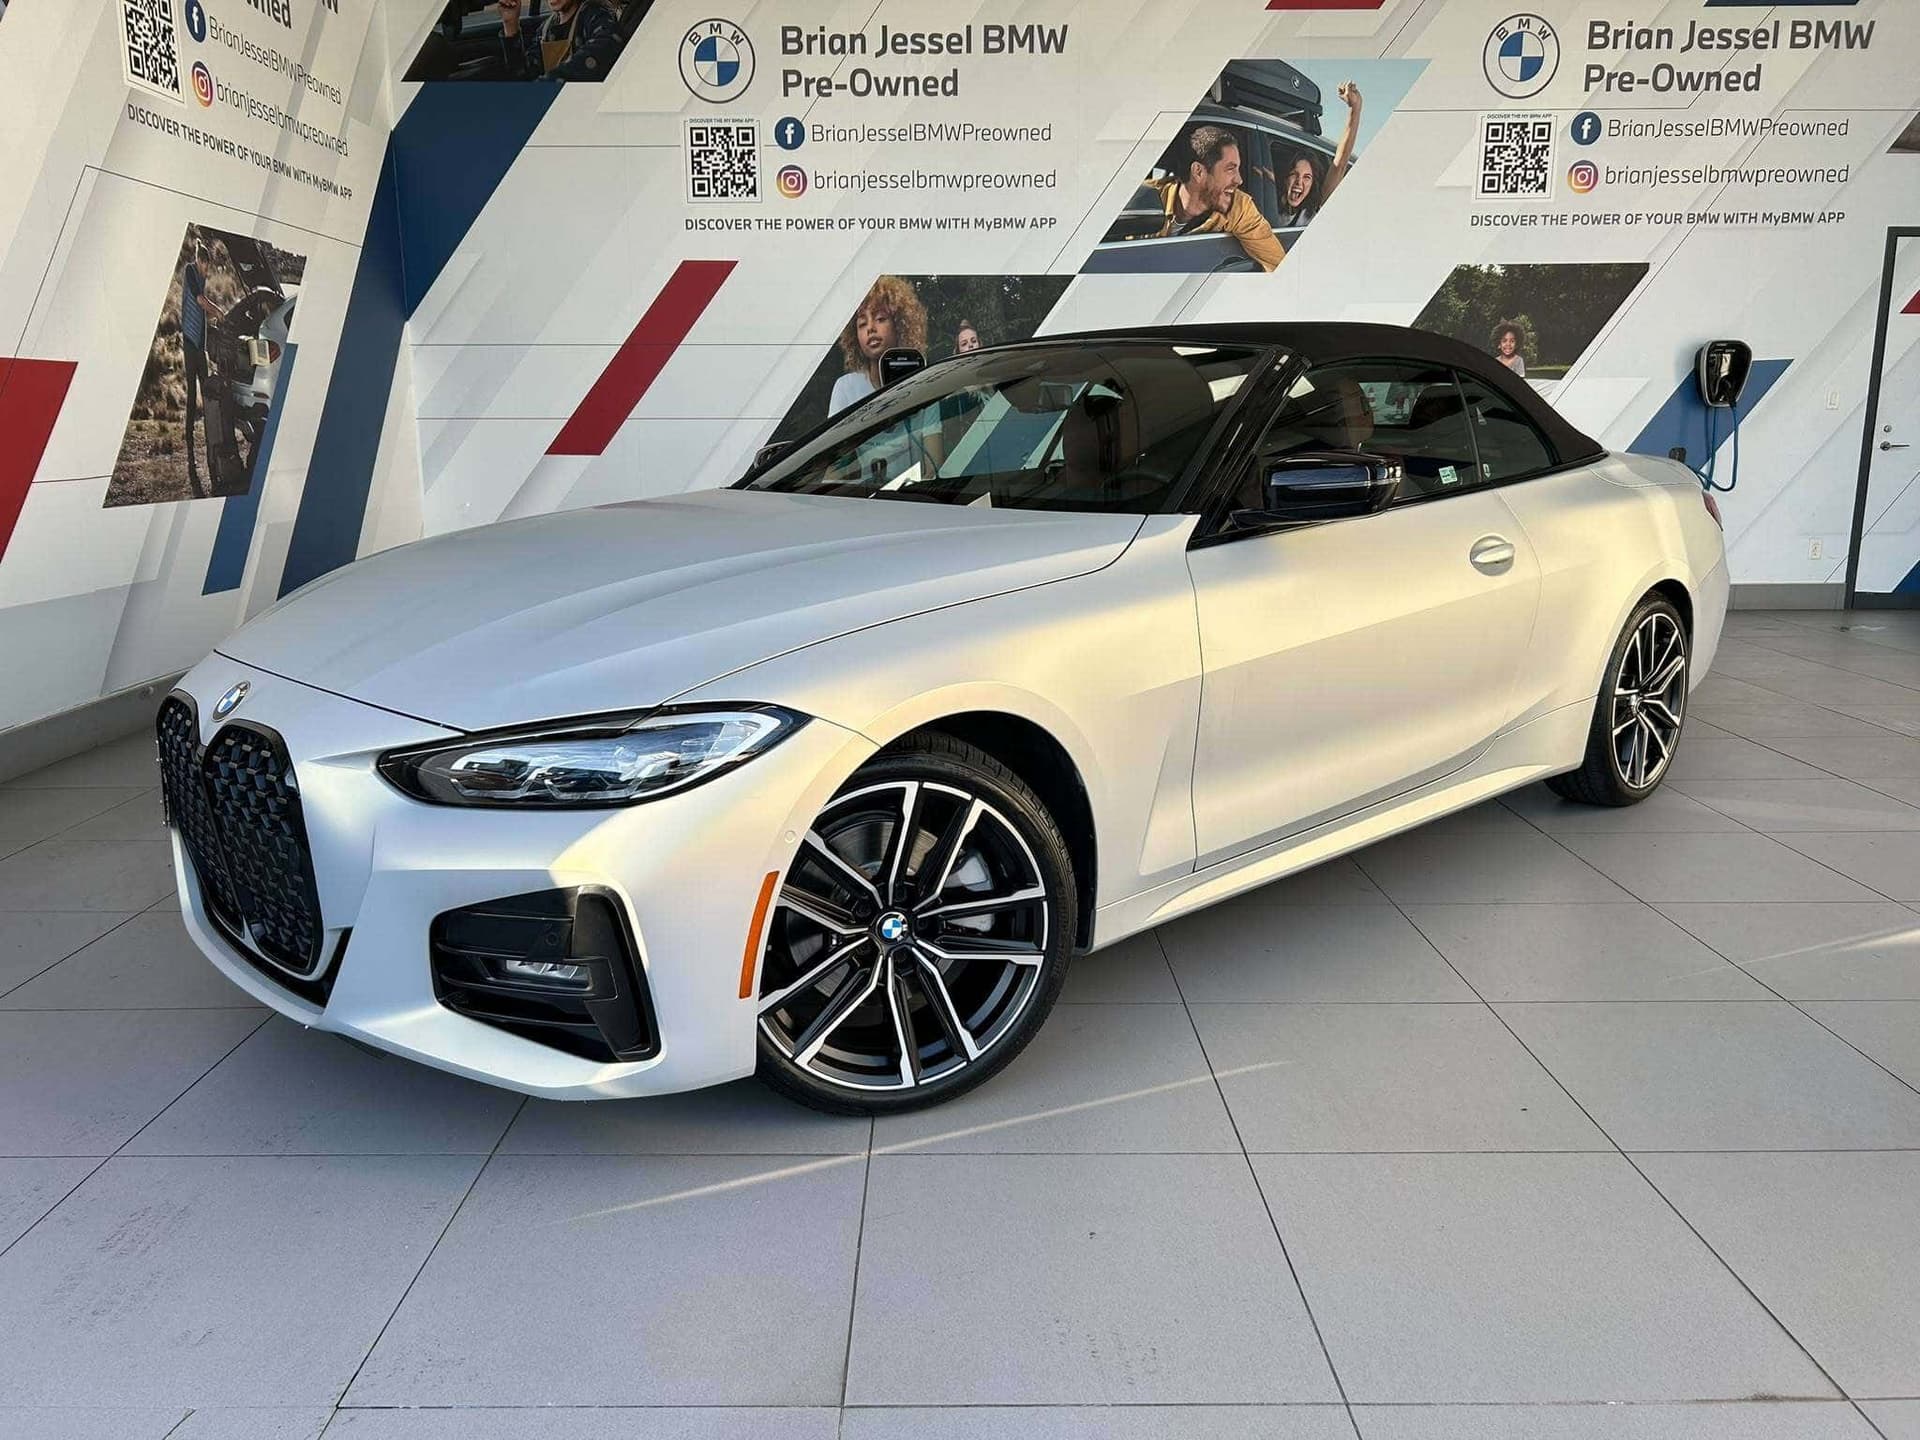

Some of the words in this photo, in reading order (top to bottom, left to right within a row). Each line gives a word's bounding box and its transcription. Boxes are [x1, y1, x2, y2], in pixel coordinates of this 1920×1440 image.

[688, 23, 745, 47] BMW
[781, 26, 867, 55] Brian
[875, 25, 972, 58] Jessel
[983, 24, 1068, 54] BMW
[1495, 18, 1551, 41] BMW
[1587, 20, 1674, 50] Brian
[1680, 20, 1780, 53] Jessel
[1789, 20, 1876, 50] BMW
[209, 16, 342, 105] BrianJesselBMWPreowned
[782, 68, 959, 97] Pre-Owned
[1584, 63, 1762, 92] Pre-Owned
[216, 77, 349, 157] brianjesselbmwpreowned
[1608, 118, 1849, 138] BrianJesselBMWPreowned
[811, 123, 1052, 143] BrianJesselBMWPreowned
[128, 104, 180, 138] DISCOVER
[181, 125, 201, 145] THE
[203, 132, 237, 157] POWER
[237, 145, 249, 161] OF
[250, 150, 272, 170] YOUR
[273, 159, 292, 178] BMW
[293, 165, 312, 184] WITH
[313, 175, 339, 195] MyBMW
[339, 185, 353, 200] APP
[814, 169, 1057, 192] brianjesselbmwpreowned
[1605, 164, 1849, 188] brianjesselbmwpreowned
[685, 218, 752, 230] DISCOVER
[755, 218, 782, 230] THE
[786, 218, 834, 230] POWER
[838, 218, 855, 229] OF
[858, 218, 895, 229] YOUR
[899, 218, 932, 229] BMW
[936, 218, 970, 229] WITH
[974, 217, 1026, 231] MyBMW
[1029, 217, 1057, 228] APP
[1470, 214, 1538, 226] DISCOVER
[1541, 214, 1568, 226] THE
[1571, 213, 1621, 225] POWER
[1624, 213, 1643, 225] OF
[1646, 213, 1682, 224] YOUR
[1687, 212, 1720, 224] BMW
[1723, 212, 1757, 224] WITH
[1762, 212, 1815, 226] MyBMW
[1817, 211, 1846, 223] APP
